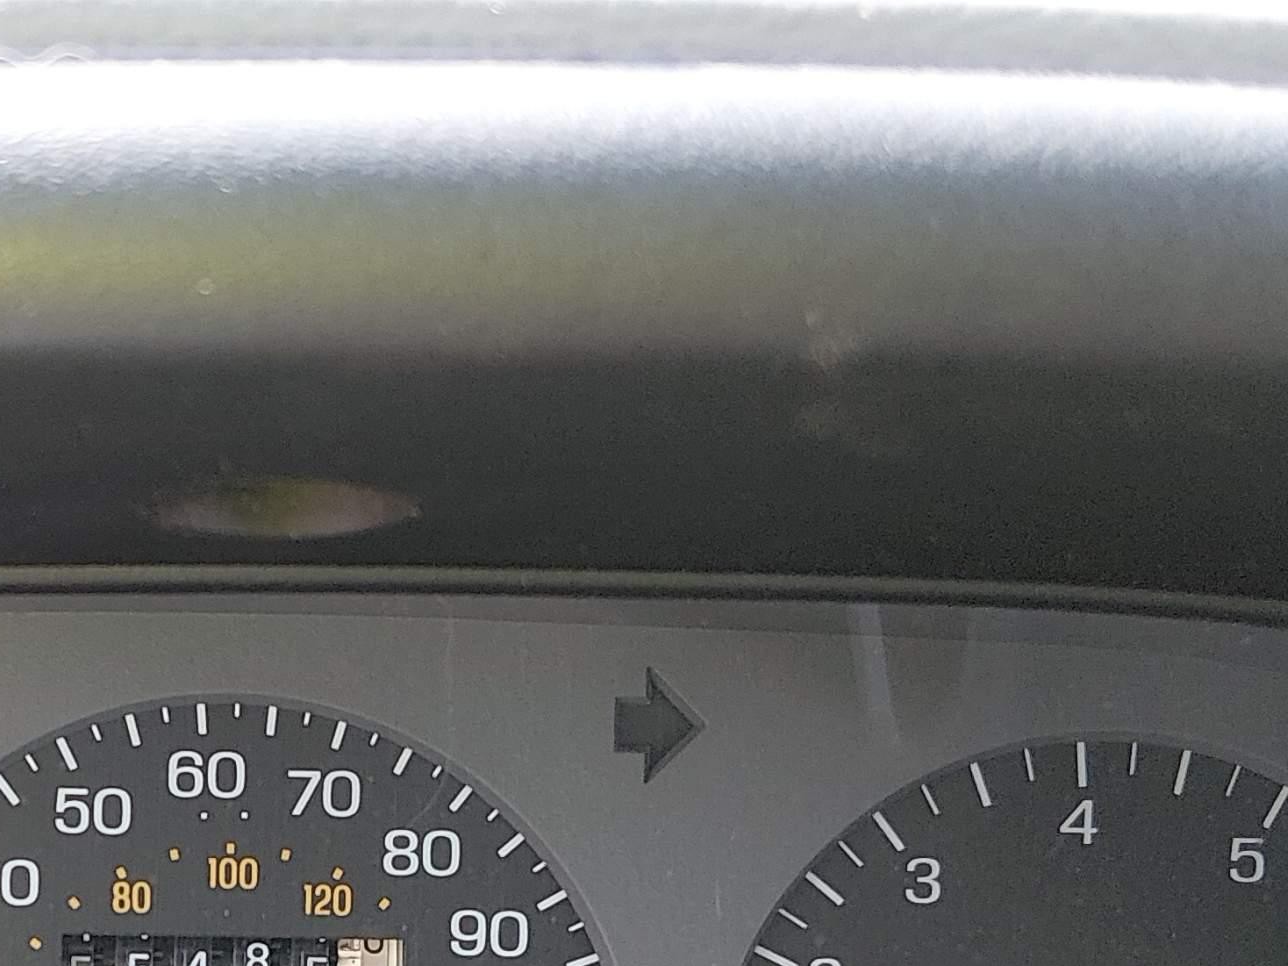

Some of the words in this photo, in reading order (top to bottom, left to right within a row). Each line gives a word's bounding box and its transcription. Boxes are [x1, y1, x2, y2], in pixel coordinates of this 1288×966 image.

[169, 751, 245, 798] 60
[288, 771, 360, 817] 70
[56, 788, 131, 834] 50
[1060, 800, 1098, 844] 4
[209, 858, 257, 889] 100
[383, 830, 460, 876] 80
[1230, 838, 1264, 882] 5
[113, 882, 150, 913] 80
[304, 885, 351, 916] 120
[906, 858, 940, 903] 3
[451, 910, 528, 956] 90
